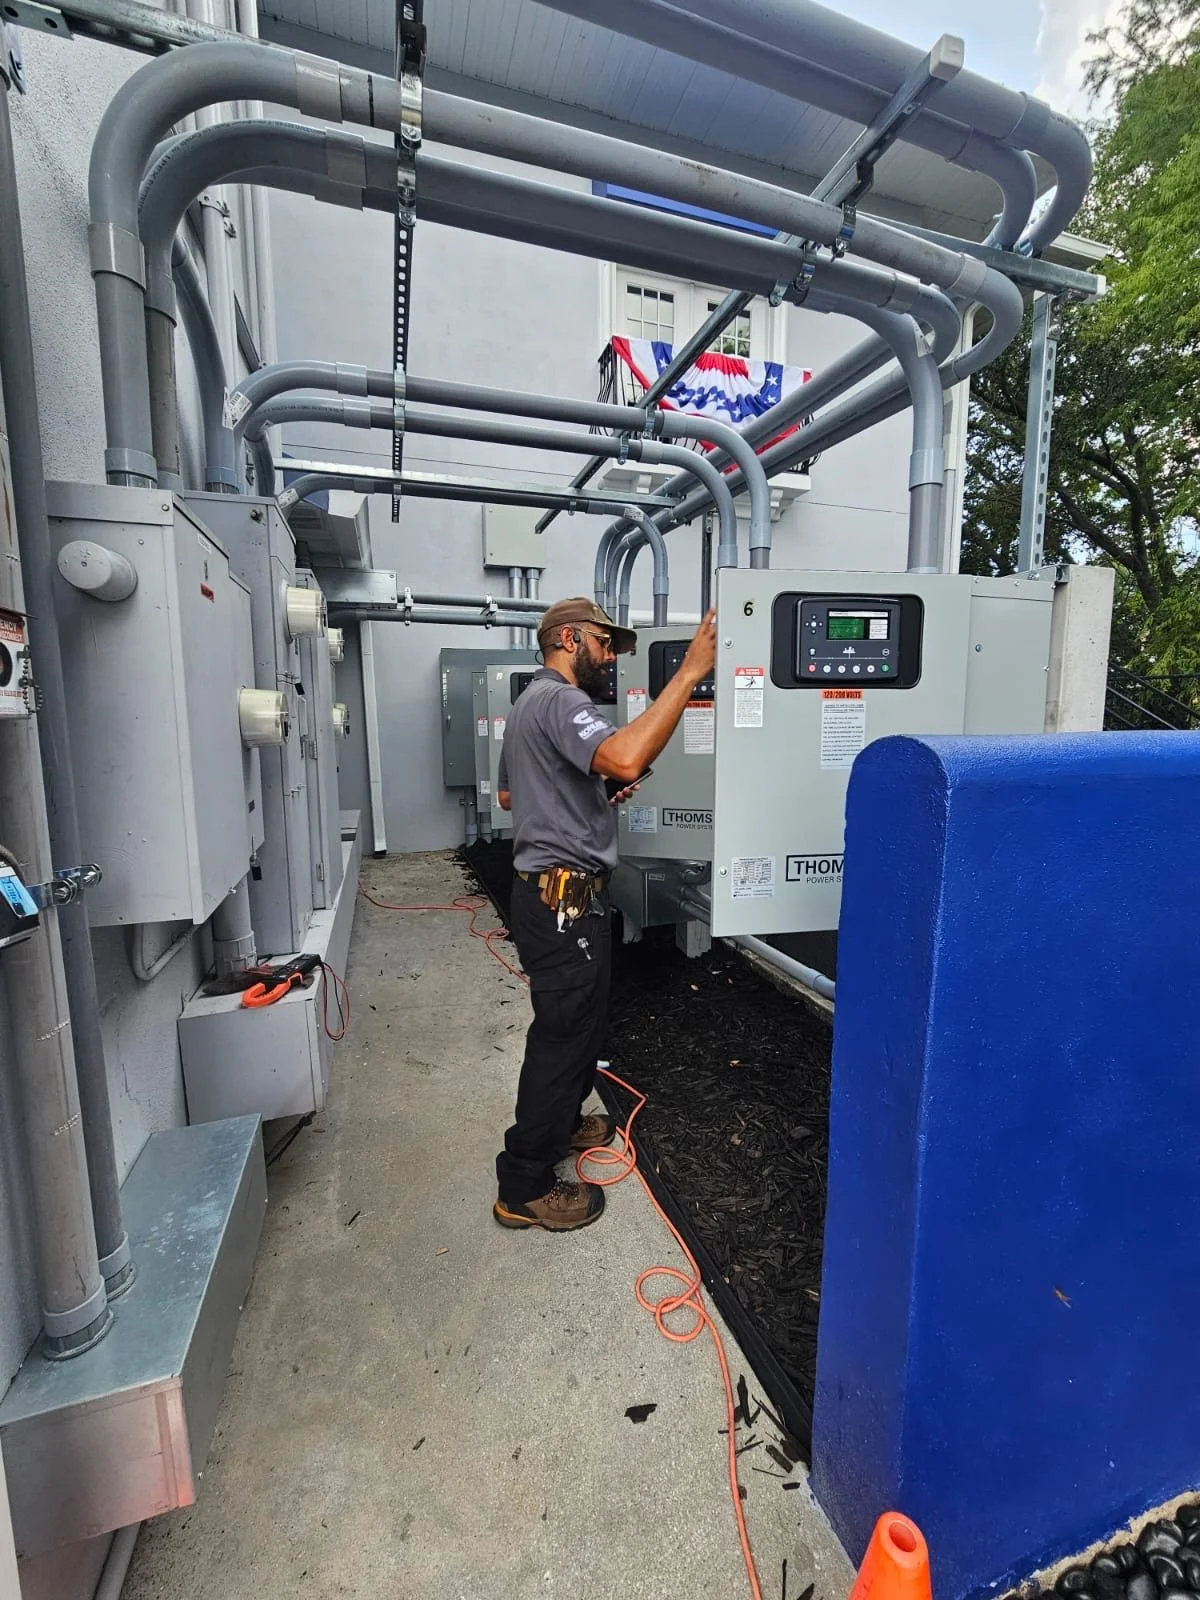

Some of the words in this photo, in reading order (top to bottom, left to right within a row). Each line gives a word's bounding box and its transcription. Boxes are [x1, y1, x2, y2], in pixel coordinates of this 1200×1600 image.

[744, 601, 754, 616] 6
[668, 812, 712, 824] THOMS
[806, 877, 835, 885] POWER
